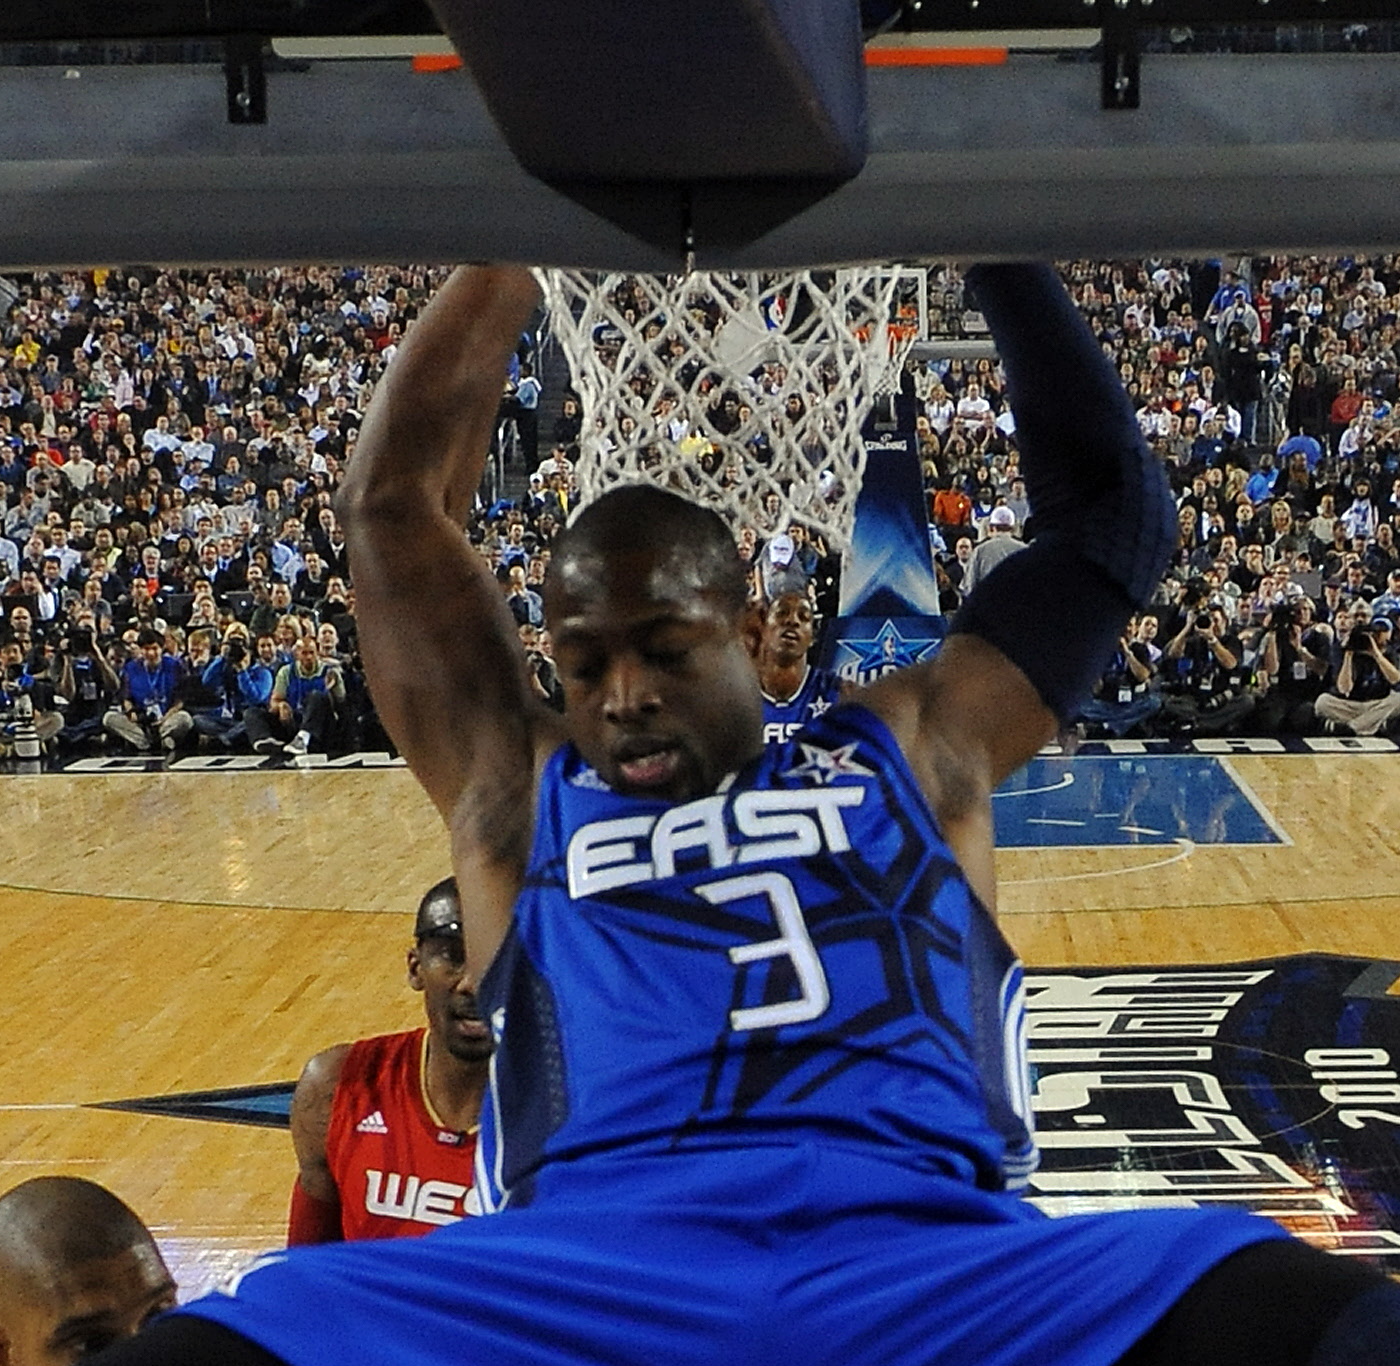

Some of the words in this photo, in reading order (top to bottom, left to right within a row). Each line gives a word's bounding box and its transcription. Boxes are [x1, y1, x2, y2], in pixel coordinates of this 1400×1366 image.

[763, 723, 804, 743] AS
[566, 786, 865, 899] EAST
[693, 871, 830, 1031] 3
[365, 1169, 483, 1226] WE
